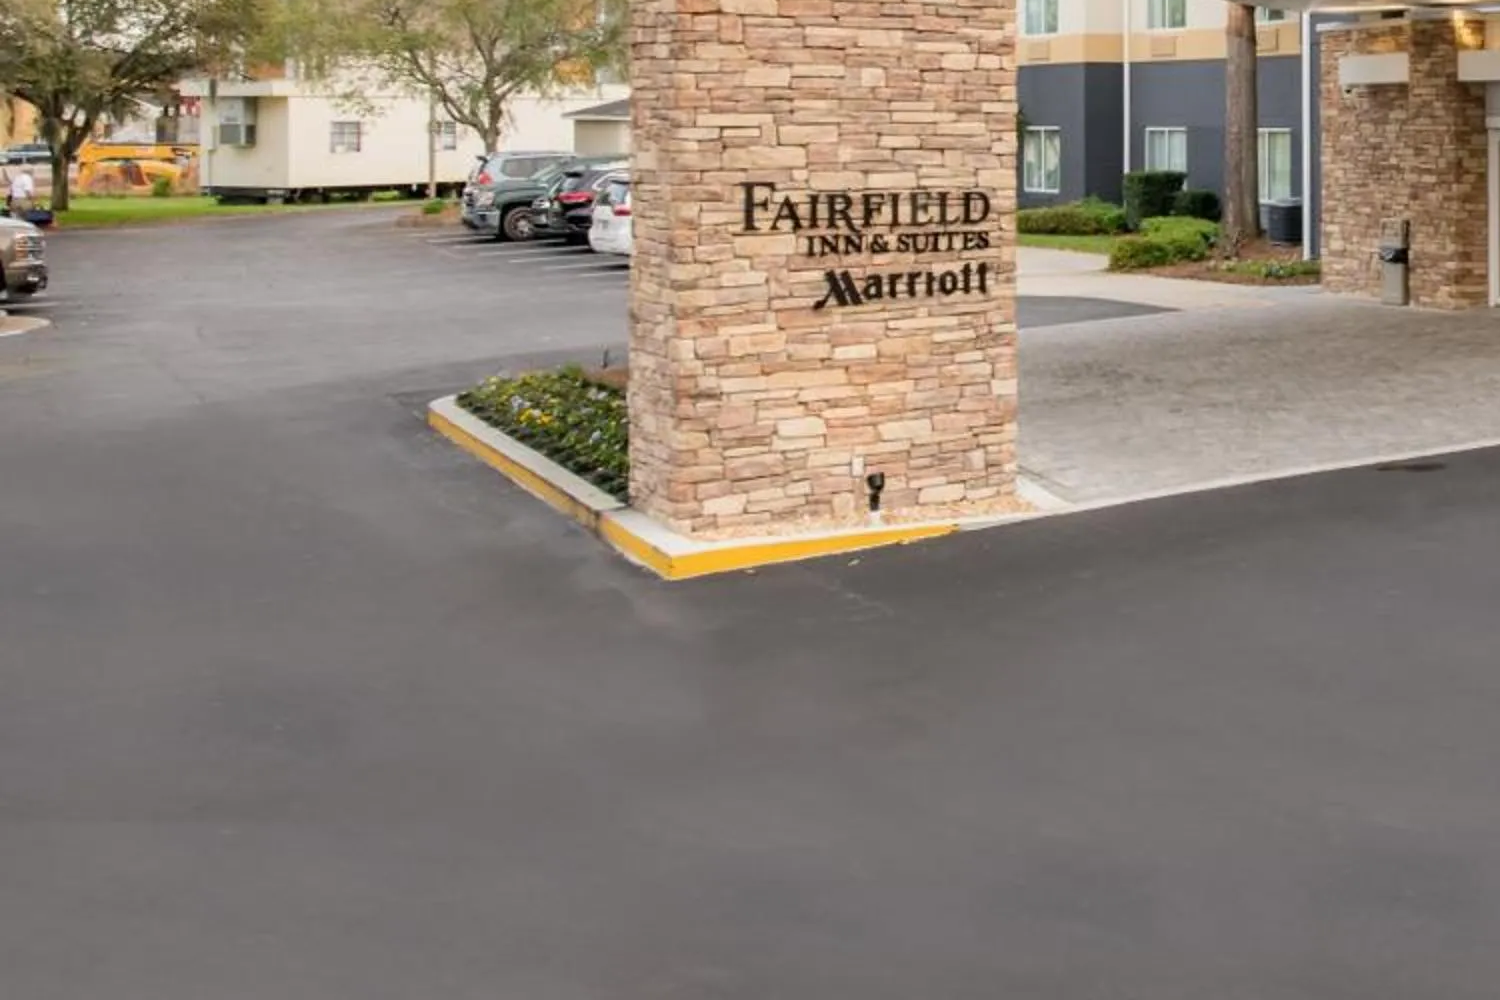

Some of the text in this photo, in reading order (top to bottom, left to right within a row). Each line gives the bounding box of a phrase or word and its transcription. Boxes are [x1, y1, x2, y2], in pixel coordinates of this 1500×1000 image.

[734, 181, 991, 233] FAIRFIELD
[806, 230, 989, 257] INN & SUITES
[812, 261, 989, 310] Marriott
